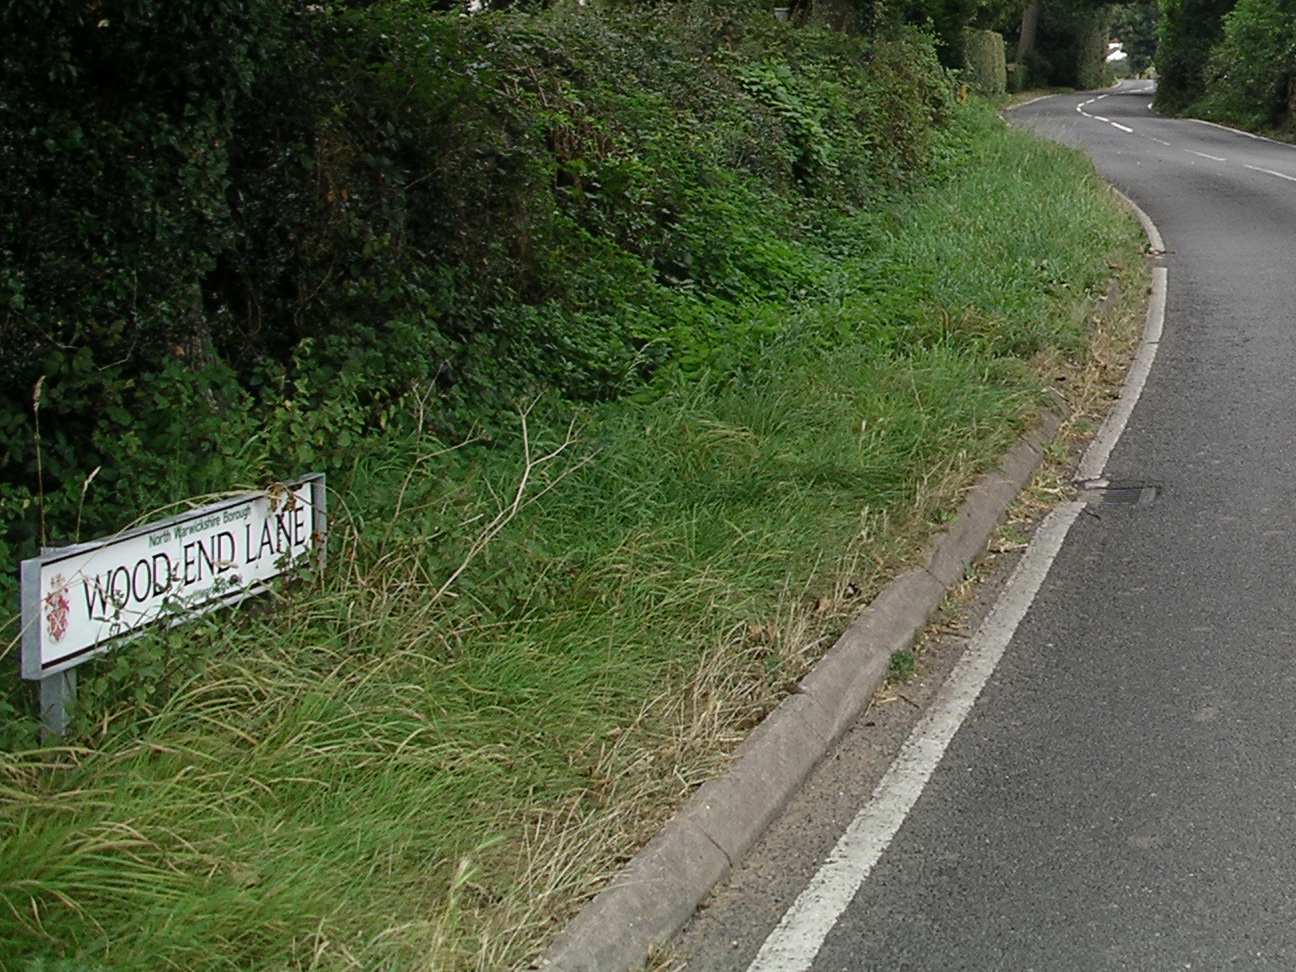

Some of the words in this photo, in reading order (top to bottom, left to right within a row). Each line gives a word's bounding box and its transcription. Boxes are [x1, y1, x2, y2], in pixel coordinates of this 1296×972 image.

[82, 551, 173, 622] WOOD
[183, 531, 236, 587] END
[246, 505, 306, 564] LANE
[149, 530, 171, 547] North
[174, 517, 221, 539] Warwickshire
[223, 506, 252, 523] Borough
